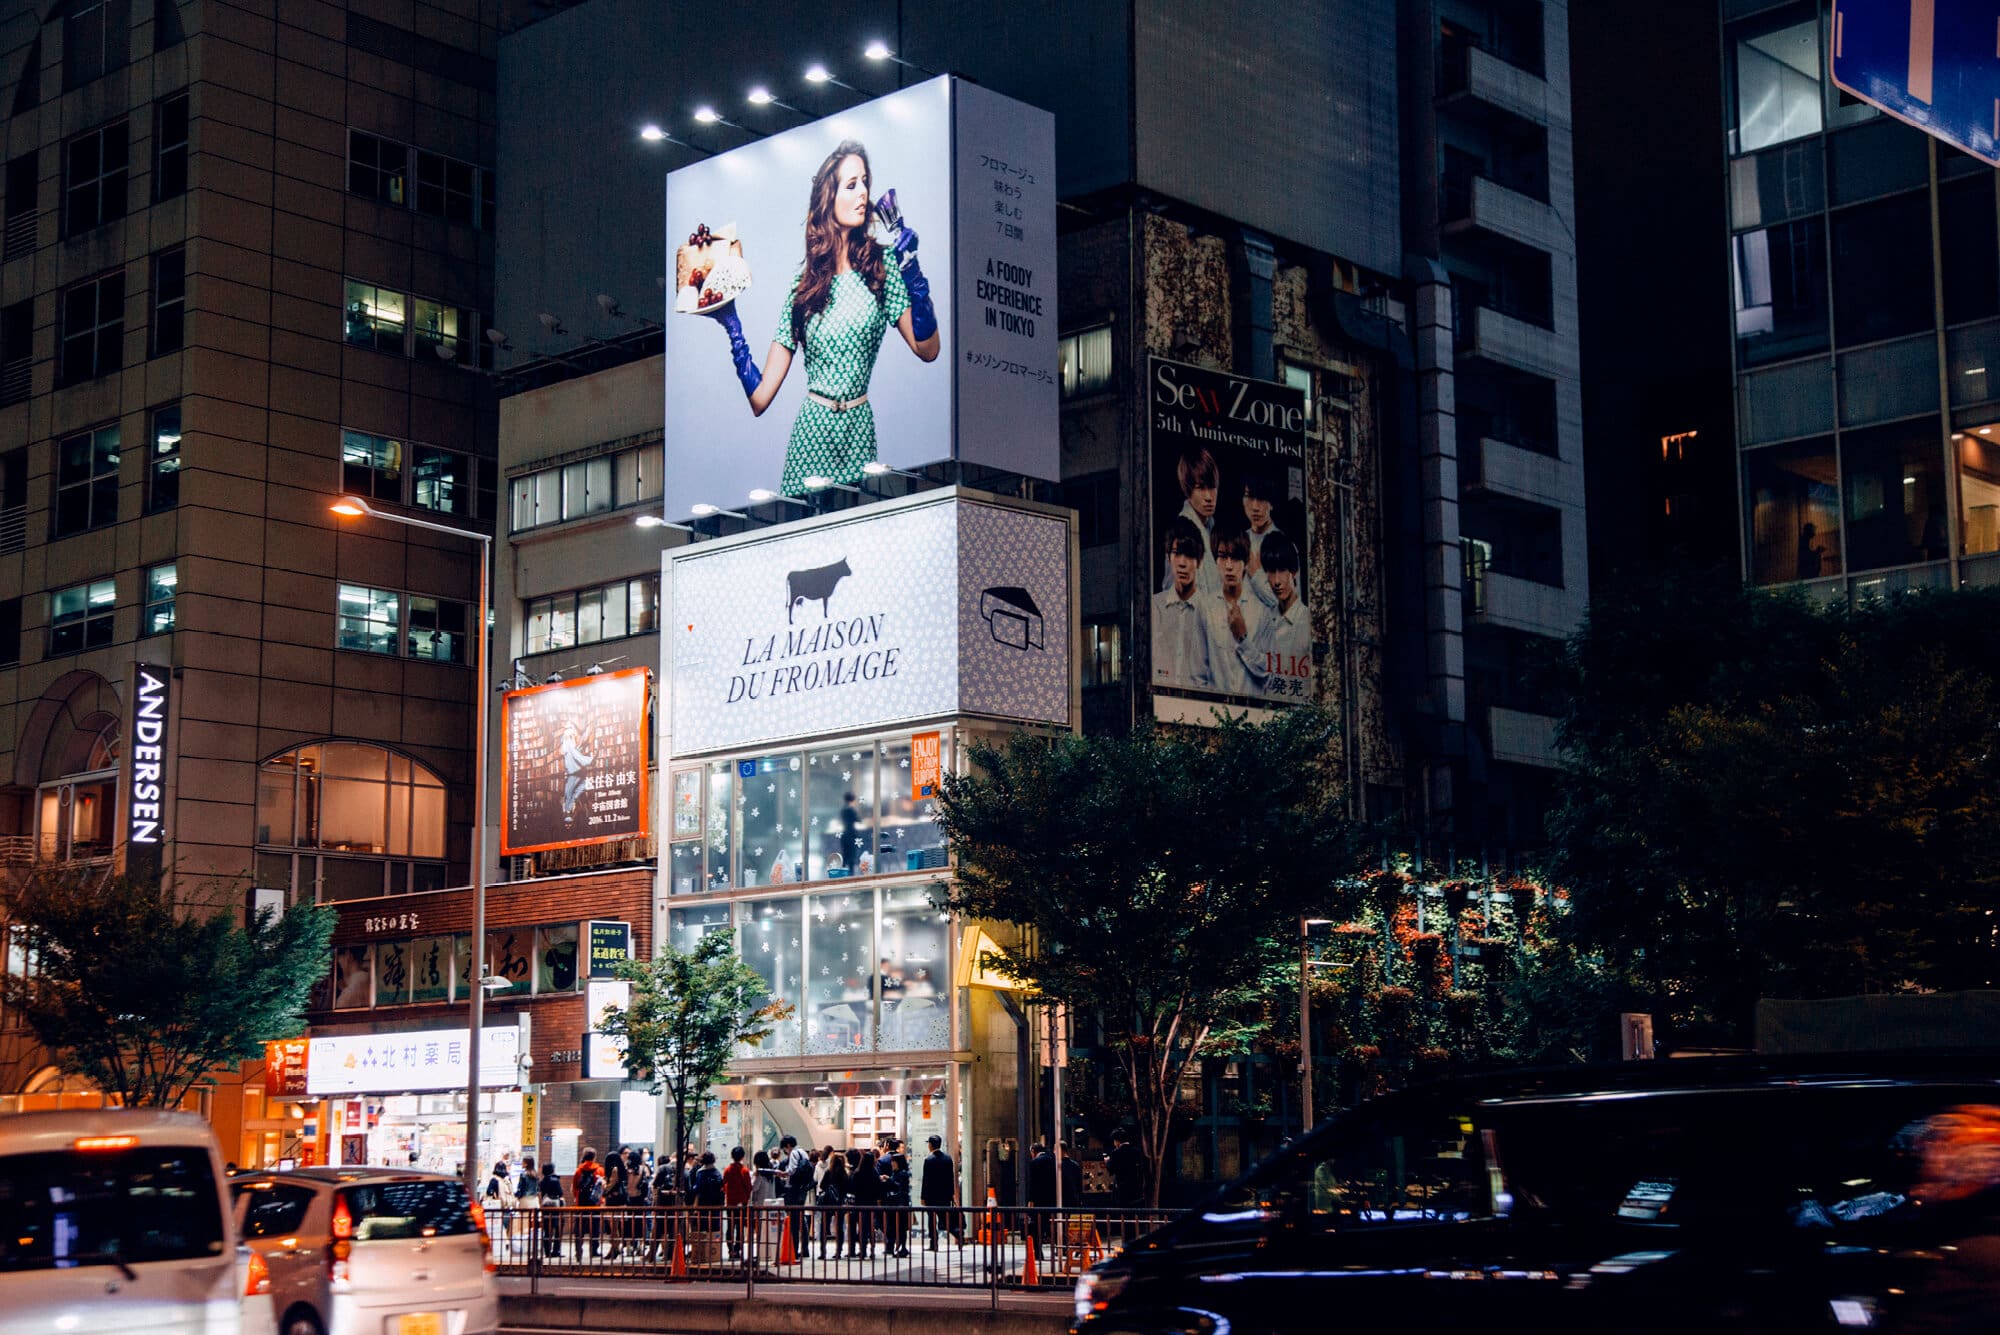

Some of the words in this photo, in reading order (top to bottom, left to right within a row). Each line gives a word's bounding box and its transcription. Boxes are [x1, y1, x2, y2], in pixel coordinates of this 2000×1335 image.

[980, 155, 1035, 185] フロマージュ
[994, 180, 1022, 199] 味わう
[994, 200, 1023, 220] 楽しむ
[986, 257, 994, 277] A
[997, 260, 1032, 288] FOODY
[977, 279, 1042, 316] EXPERIENCE
[985, 306, 997, 328] IN
[1000, 311, 1035, 338] TOKYO
[966, 350, 1055, 384] #メゾンフロマージュ
[1228, 380, 1303, 432] Zone
[1157, 412, 1182, 433] 5th
[1190, 417, 1271, 457] Anniversary
[1275, 437, 1302, 458] Best
[742, 634, 776, 666] LA
[780, 613, 885, 660] MAISON
[726, 671, 766, 704] DU
[768, 648, 900, 697] FROMAGE
[1265, 652, 1310, 678] 11.16
[1271, 677, 1304, 697] 発売
[132, 671, 165, 843] ANDERSEN
[914, 736, 939, 759] ENJOY
[382, 1041, 461, 1069] 北村薬局
